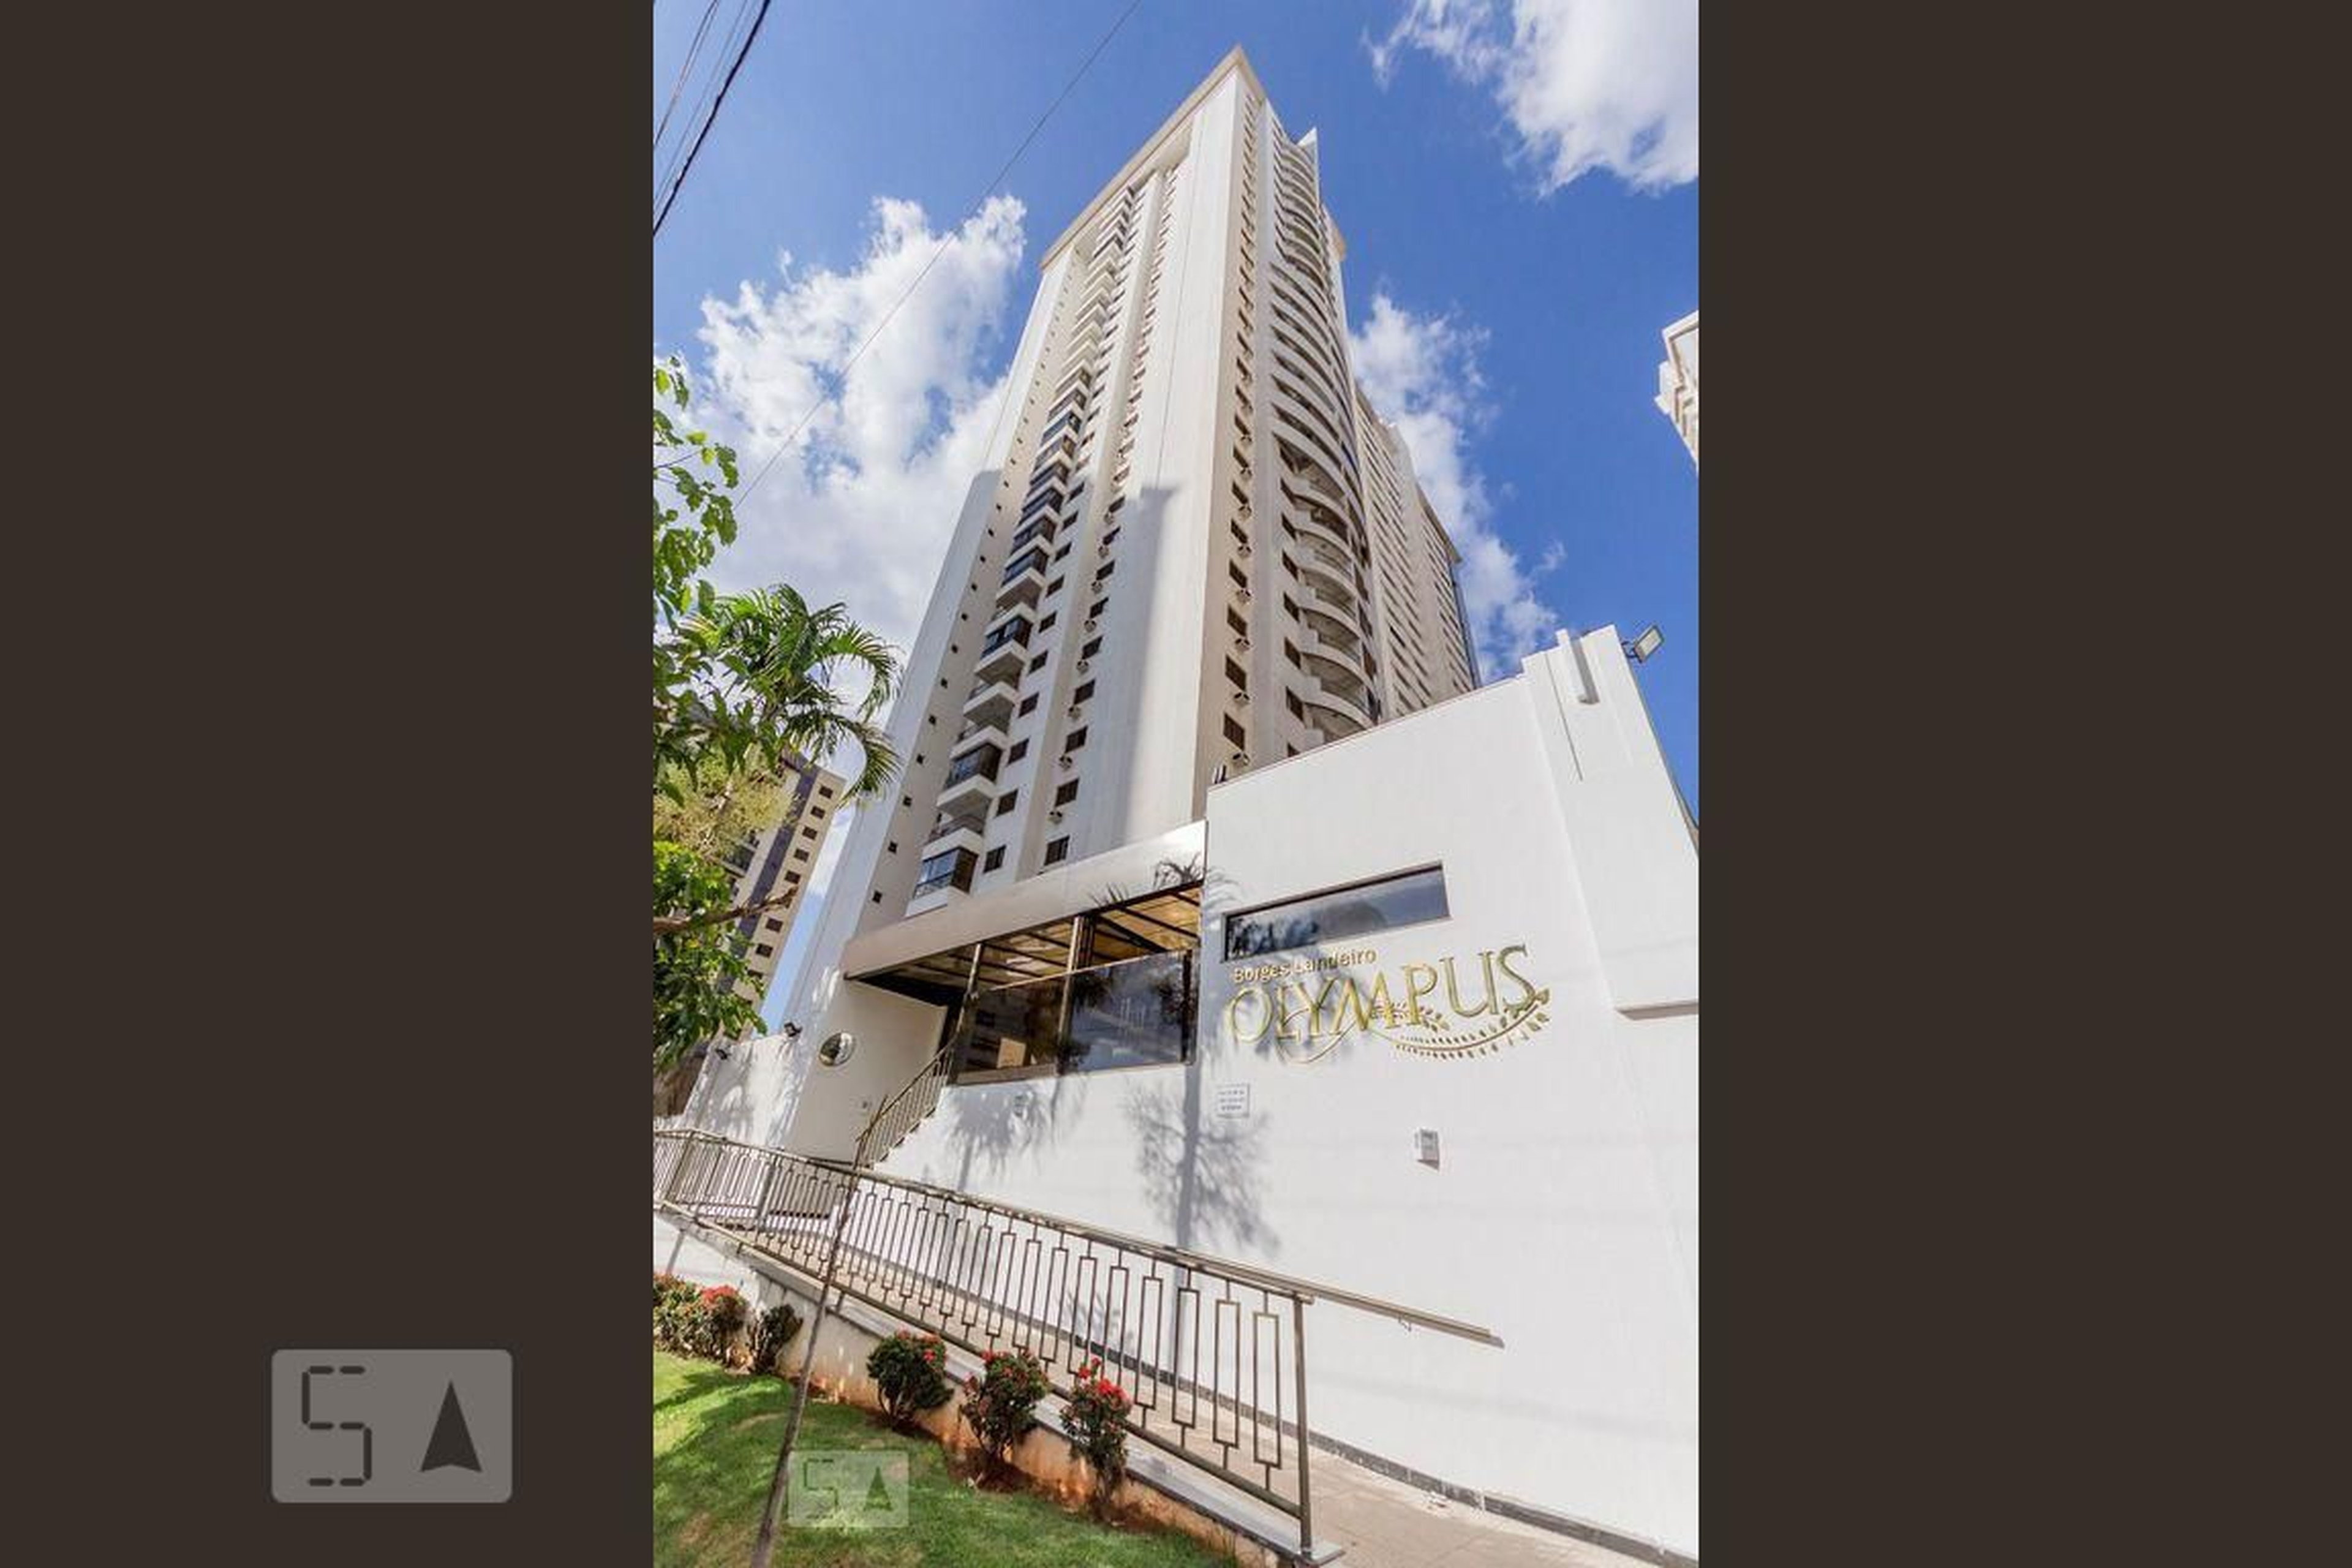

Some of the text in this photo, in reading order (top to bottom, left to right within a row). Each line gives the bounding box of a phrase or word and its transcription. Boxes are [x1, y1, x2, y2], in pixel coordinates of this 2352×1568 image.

[1228, 943, 1536, 1044] OLYMPUS
[1232, 948, 1378, 983] Borges Landeiro
